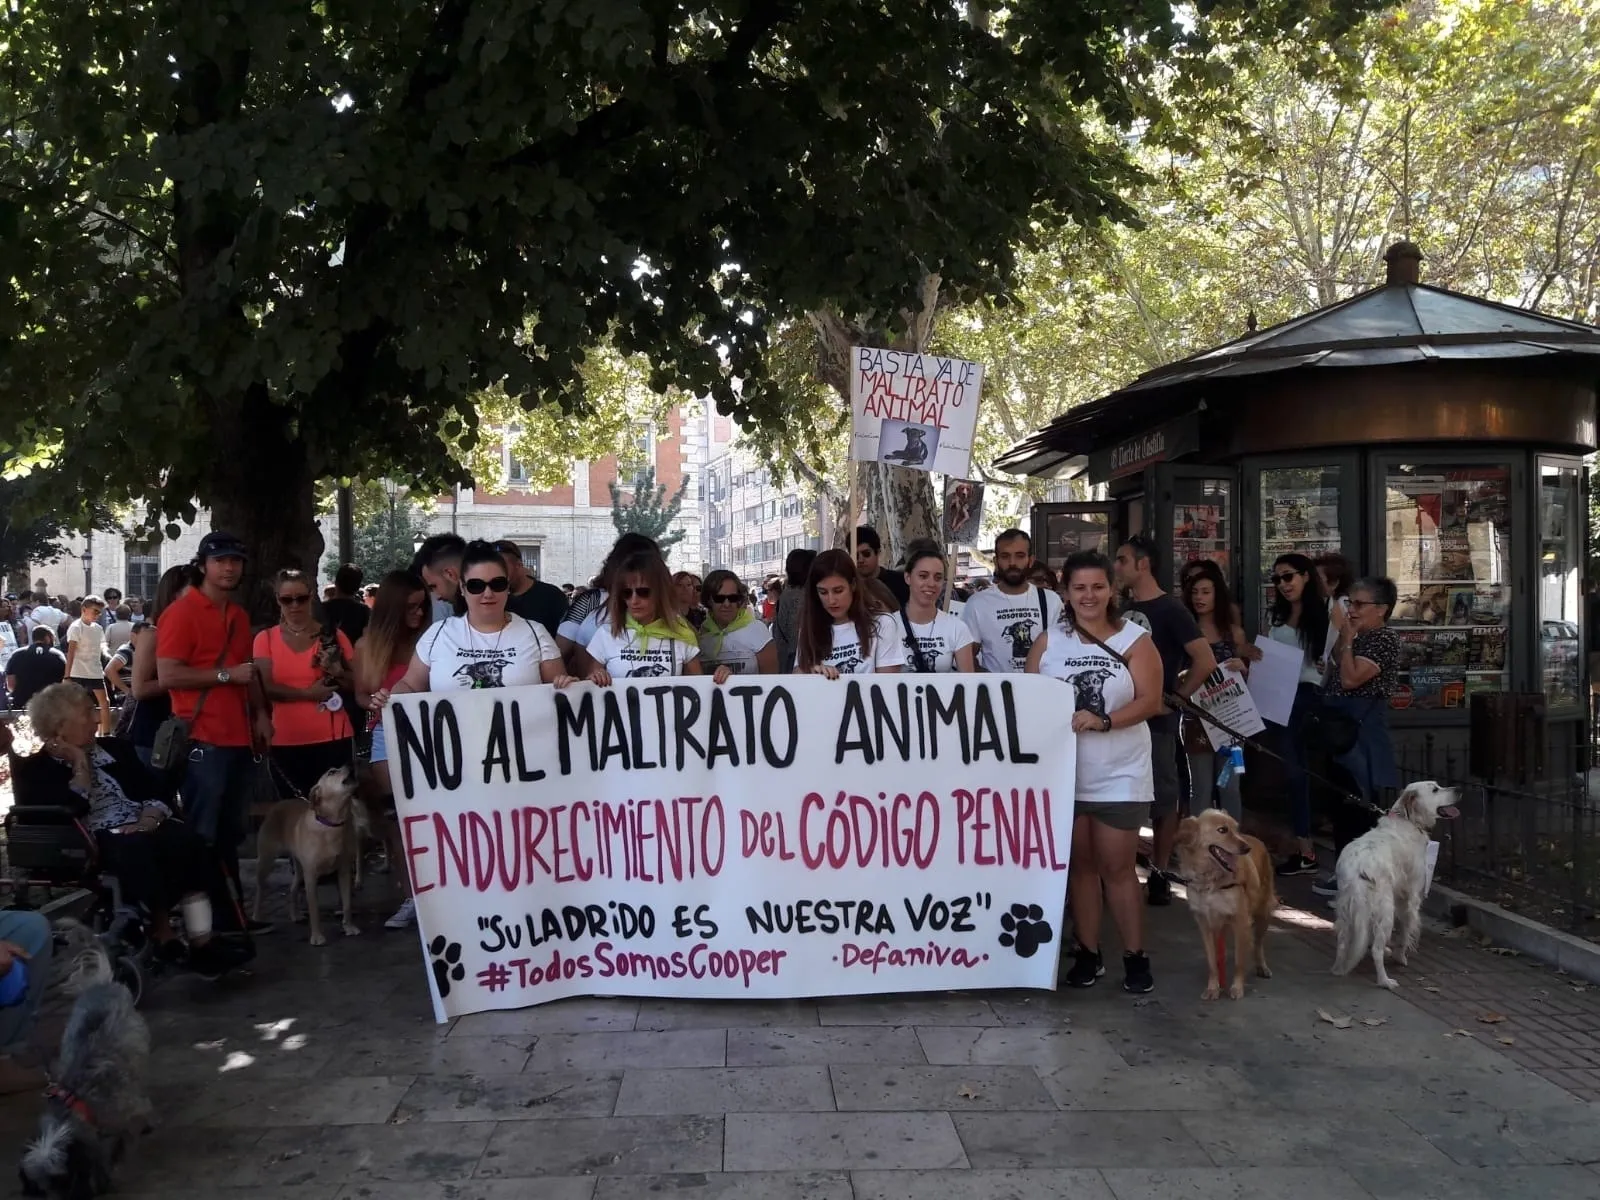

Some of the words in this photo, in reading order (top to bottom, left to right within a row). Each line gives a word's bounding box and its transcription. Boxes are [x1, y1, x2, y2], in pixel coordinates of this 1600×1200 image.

[859, 348, 924, 378] BASTA
[935, 358, 955, 385] YA
[958, 362, 976, 386] DE
[859, 370, 965, 408] MALTRATO
[863, 393, 950, 429] ANIMAL
[997, 612, 1032, 620] NOSOTROS
[620, 654, 663, 662] NOSOTROS
[825, 648, 857, 661] OSOTROS
[1064, 660, 1111, 668] NOSOTROS
[392, 699, 463, 799] NO
[481, 699, 546, 784] AL
[554, 685, 798, 776] MALTRATO
[951, 787, 1067, 872] PENAL
[671, 904, 719, 939] ES
[745, 899, 896, 936] NUESTRA
[476, 942, 787, 992] #TodosSomosCooper
